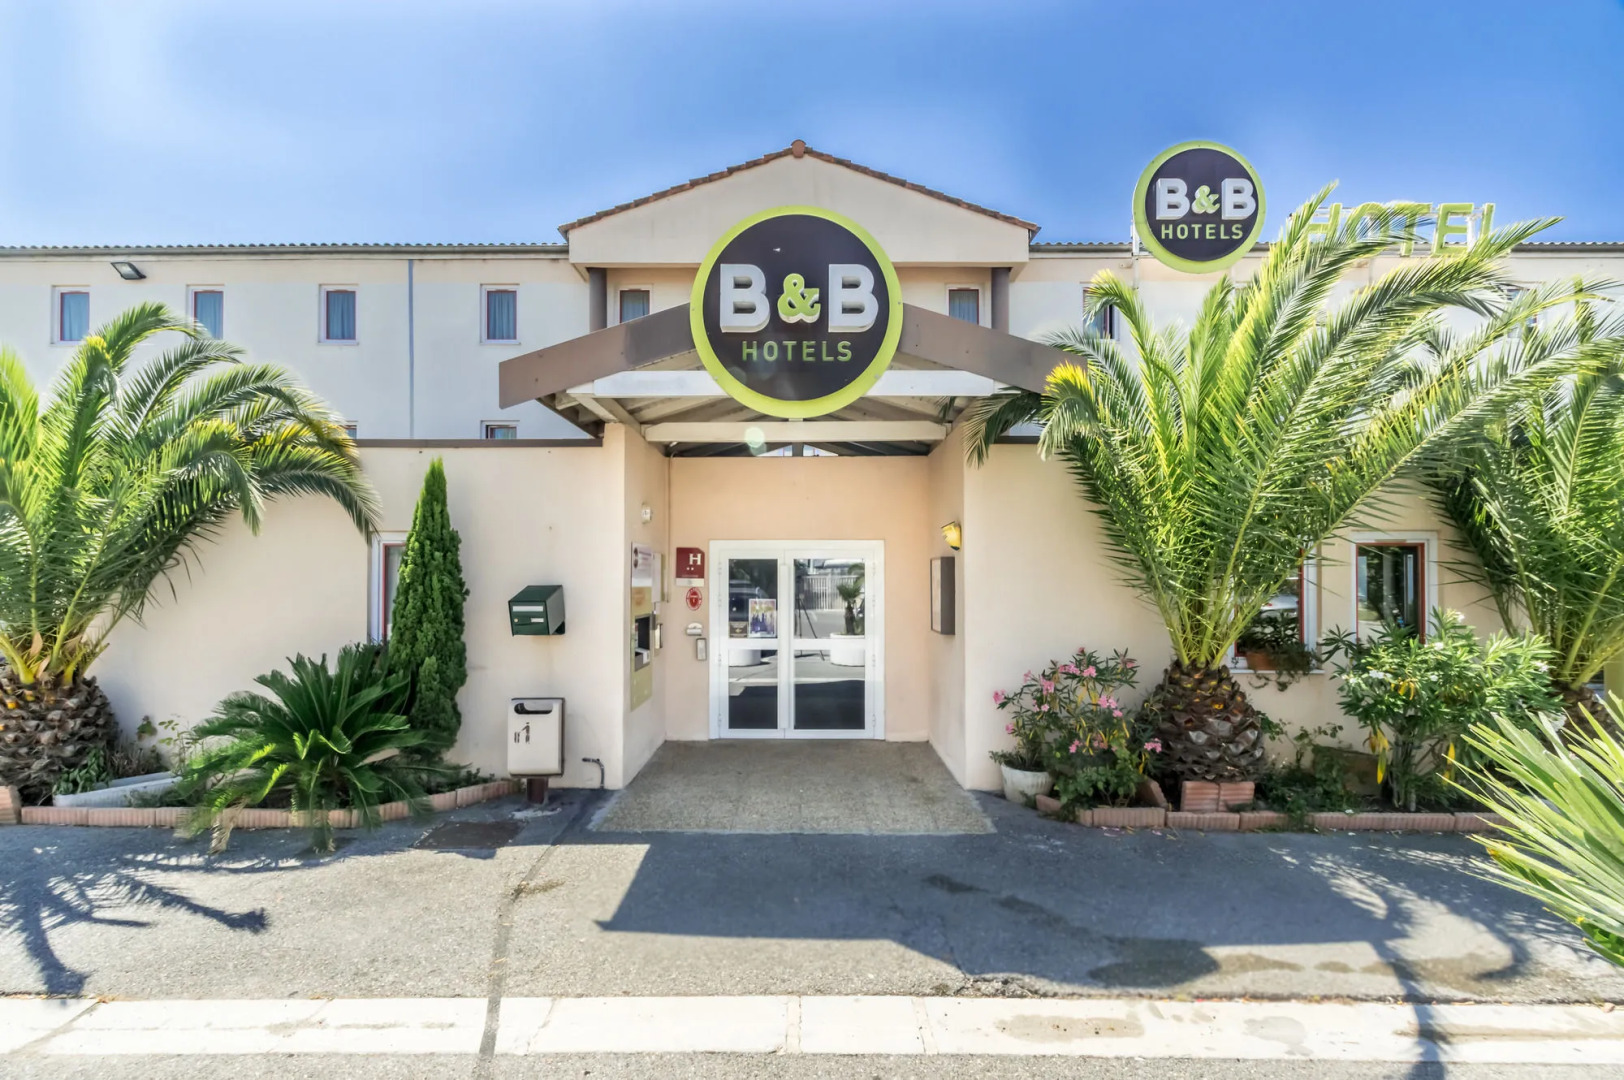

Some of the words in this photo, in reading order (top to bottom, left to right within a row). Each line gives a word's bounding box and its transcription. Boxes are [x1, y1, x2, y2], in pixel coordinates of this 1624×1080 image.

[1156, 178, 1256, 220] B&B
[1161, 223, 1244, 240] HOTELS
[720, 263, 879, 333] B&B
[742, 340, 853, 362] HOTELS
[689, 553, 701, 565] H
